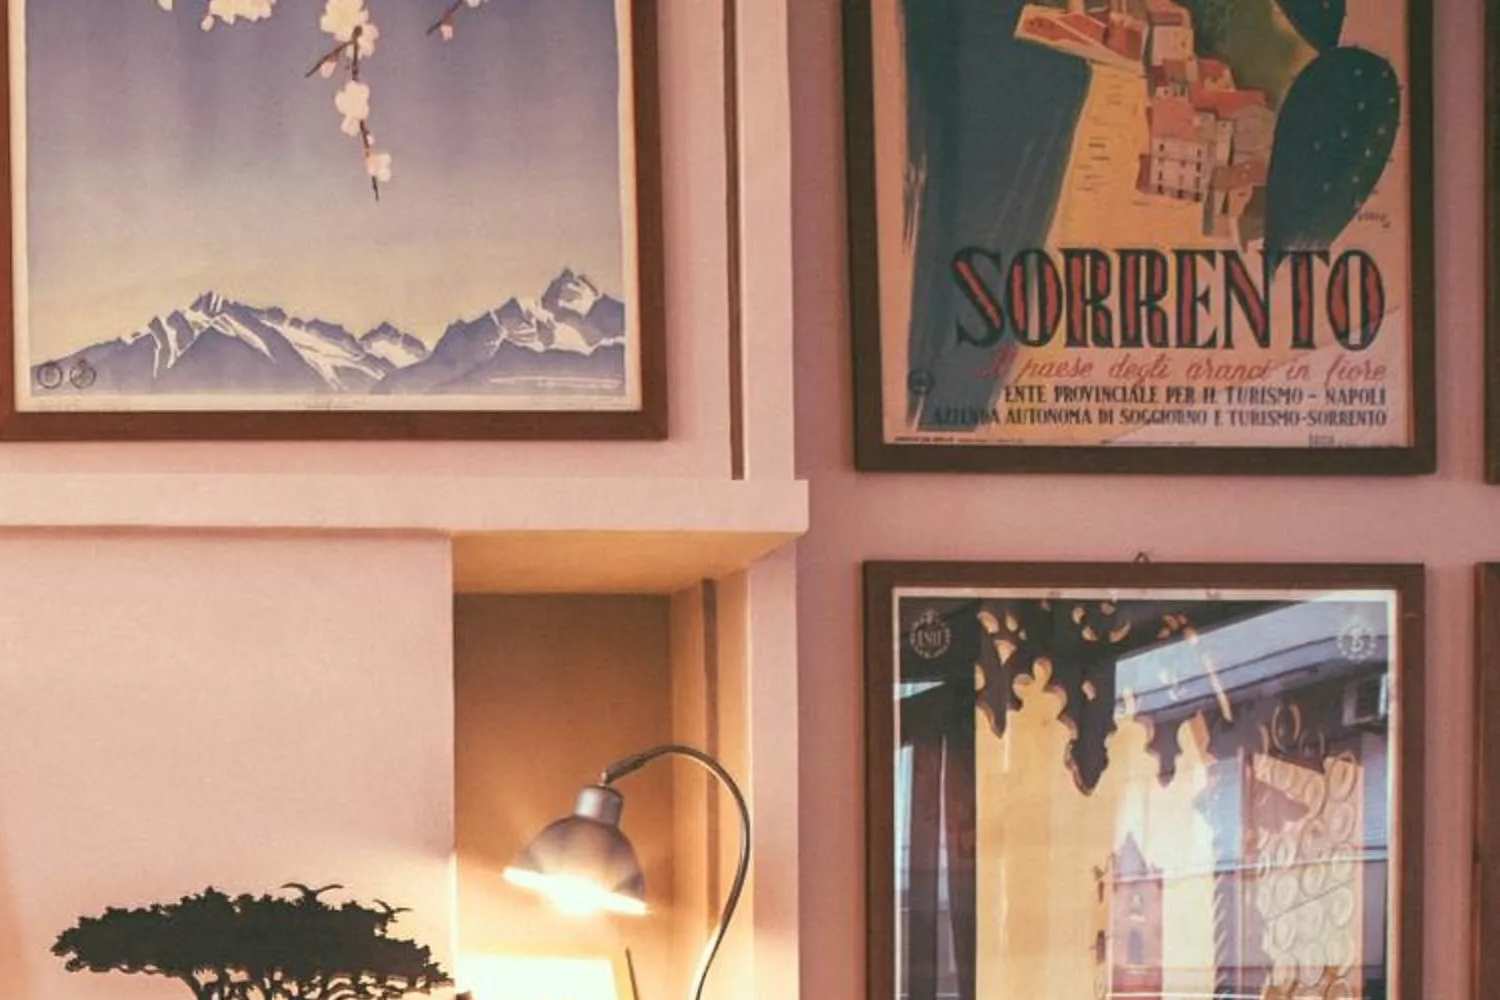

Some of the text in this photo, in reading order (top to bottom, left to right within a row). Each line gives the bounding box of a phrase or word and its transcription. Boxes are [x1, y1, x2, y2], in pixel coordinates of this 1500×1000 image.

[949, 244, 1385, 351] SORRENTO
[1014, 354, 1094, 384] paese
[1108, 352, 1173, 386] degli
[1285, 355, 1309, 381] in
[1323, 353, 1387, 387] fiore
[1004, 385, 1047, 403] ENTE
[1054, 385, 1157, 404] PROVINCIALE
[1165, 387, 1195, 405] PER
[1226, 387, 1304, 406] TURISMO
[1325, 387, 1387, 406] NAPOLI
[1004, 408, 1092, 426] AUTONOMA
[1098, 409, 1114, 426] DI
[1120, 408, 1208, 427] SOGGIORNO
[1213, 409, 1224, 427] E
